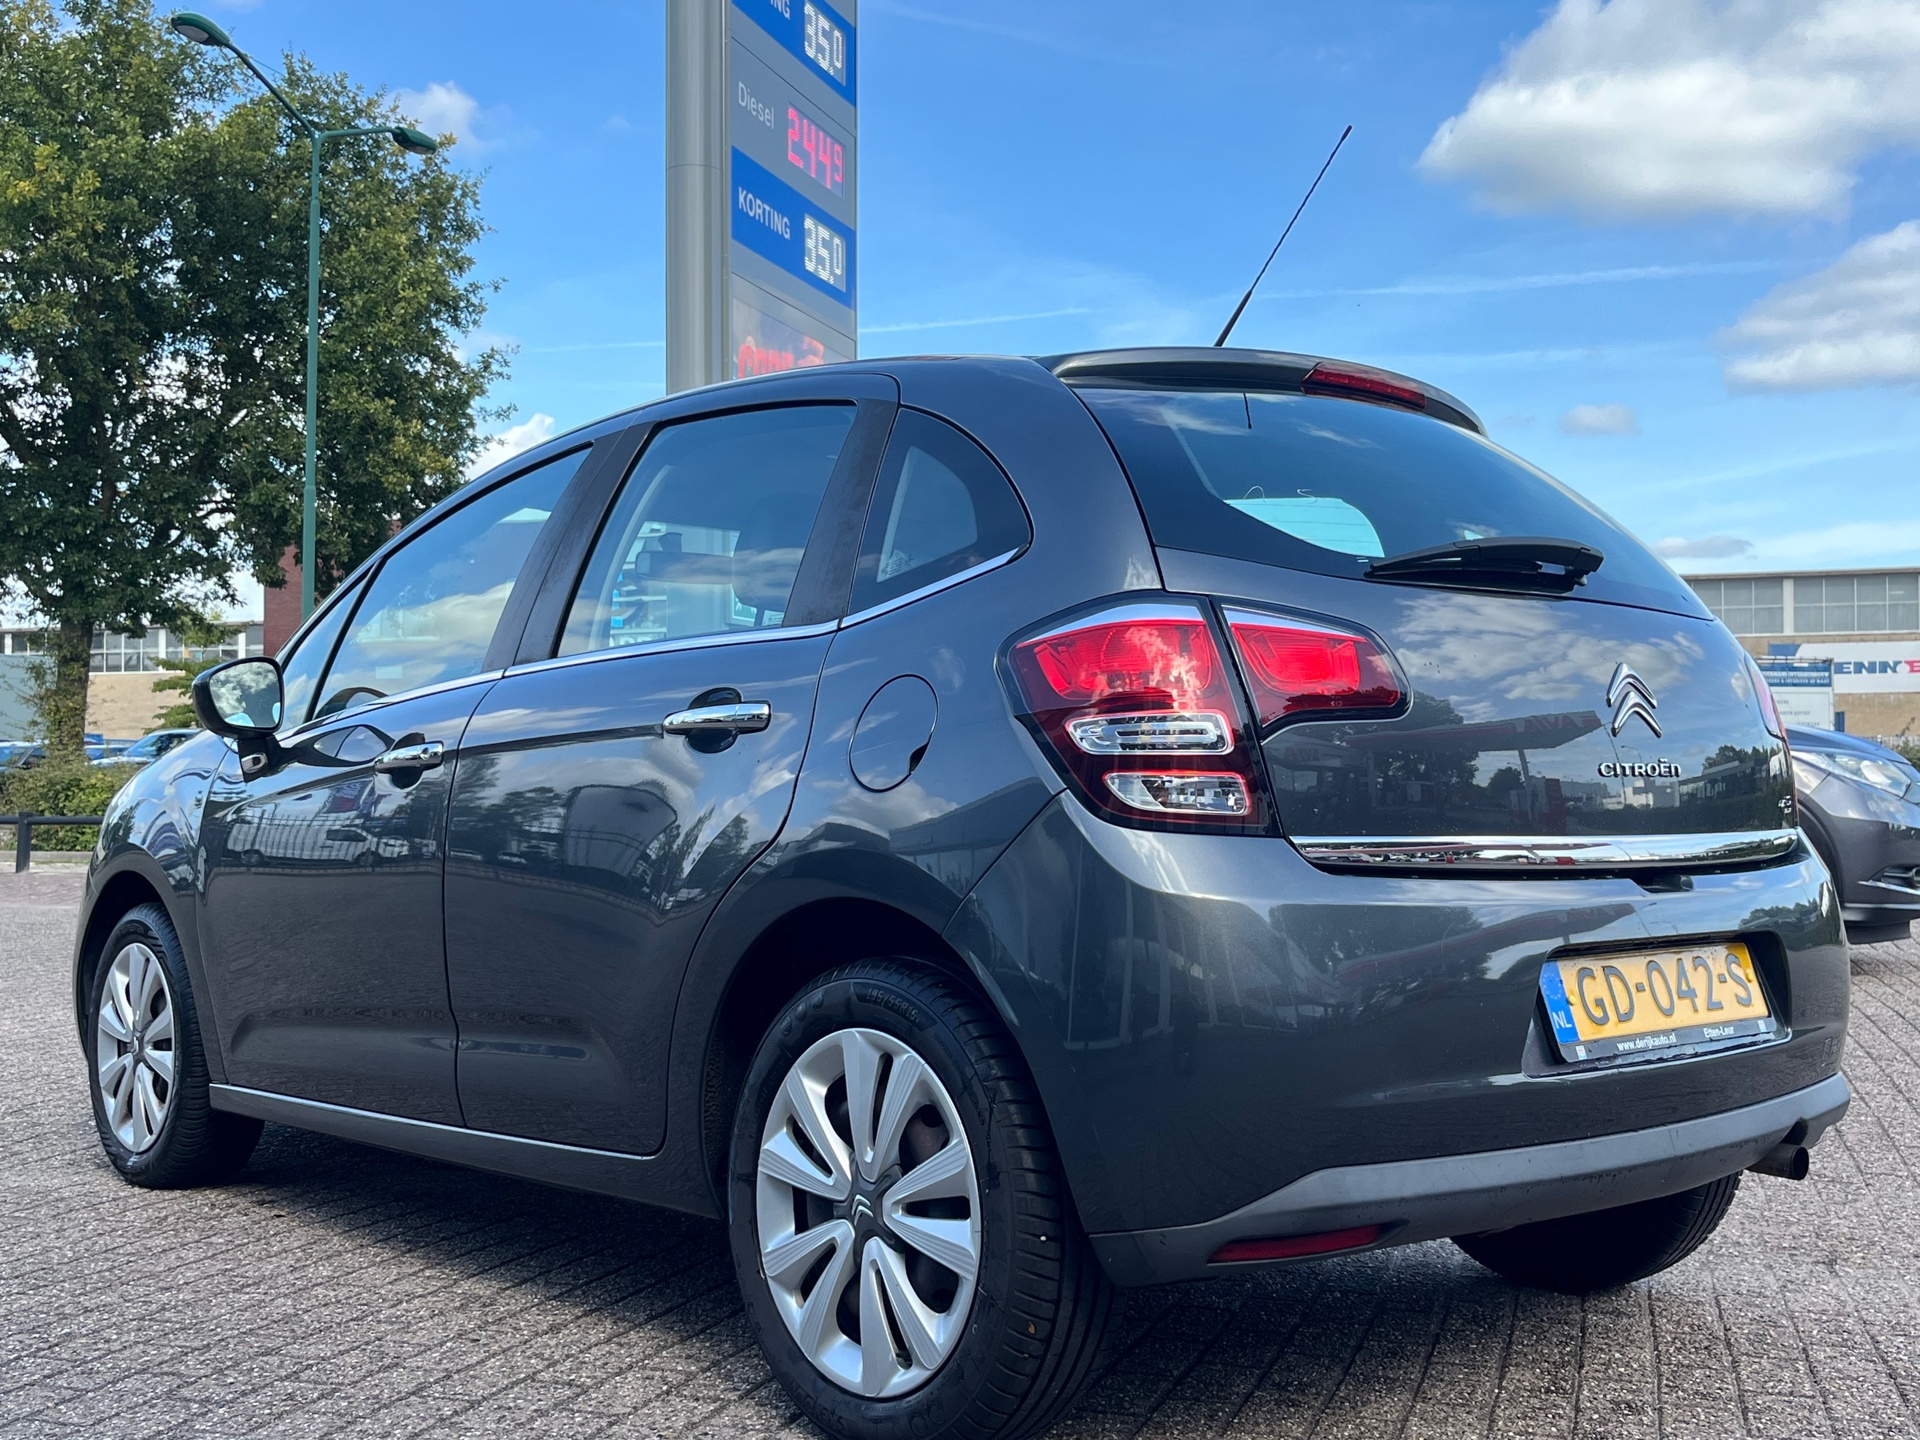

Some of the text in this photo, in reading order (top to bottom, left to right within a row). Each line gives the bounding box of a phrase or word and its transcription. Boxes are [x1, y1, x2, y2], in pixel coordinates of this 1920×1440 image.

[738, 81, 774, 129] Diesel
[738, 187, 790, 240] KORTING
[1577, 953, 1753, 1026] GD-042-S
[1552, 1011, 1572, 1029] NL
[1617, 1026, 1735, 1052] www.derijkauto.nl Etten-Leur
